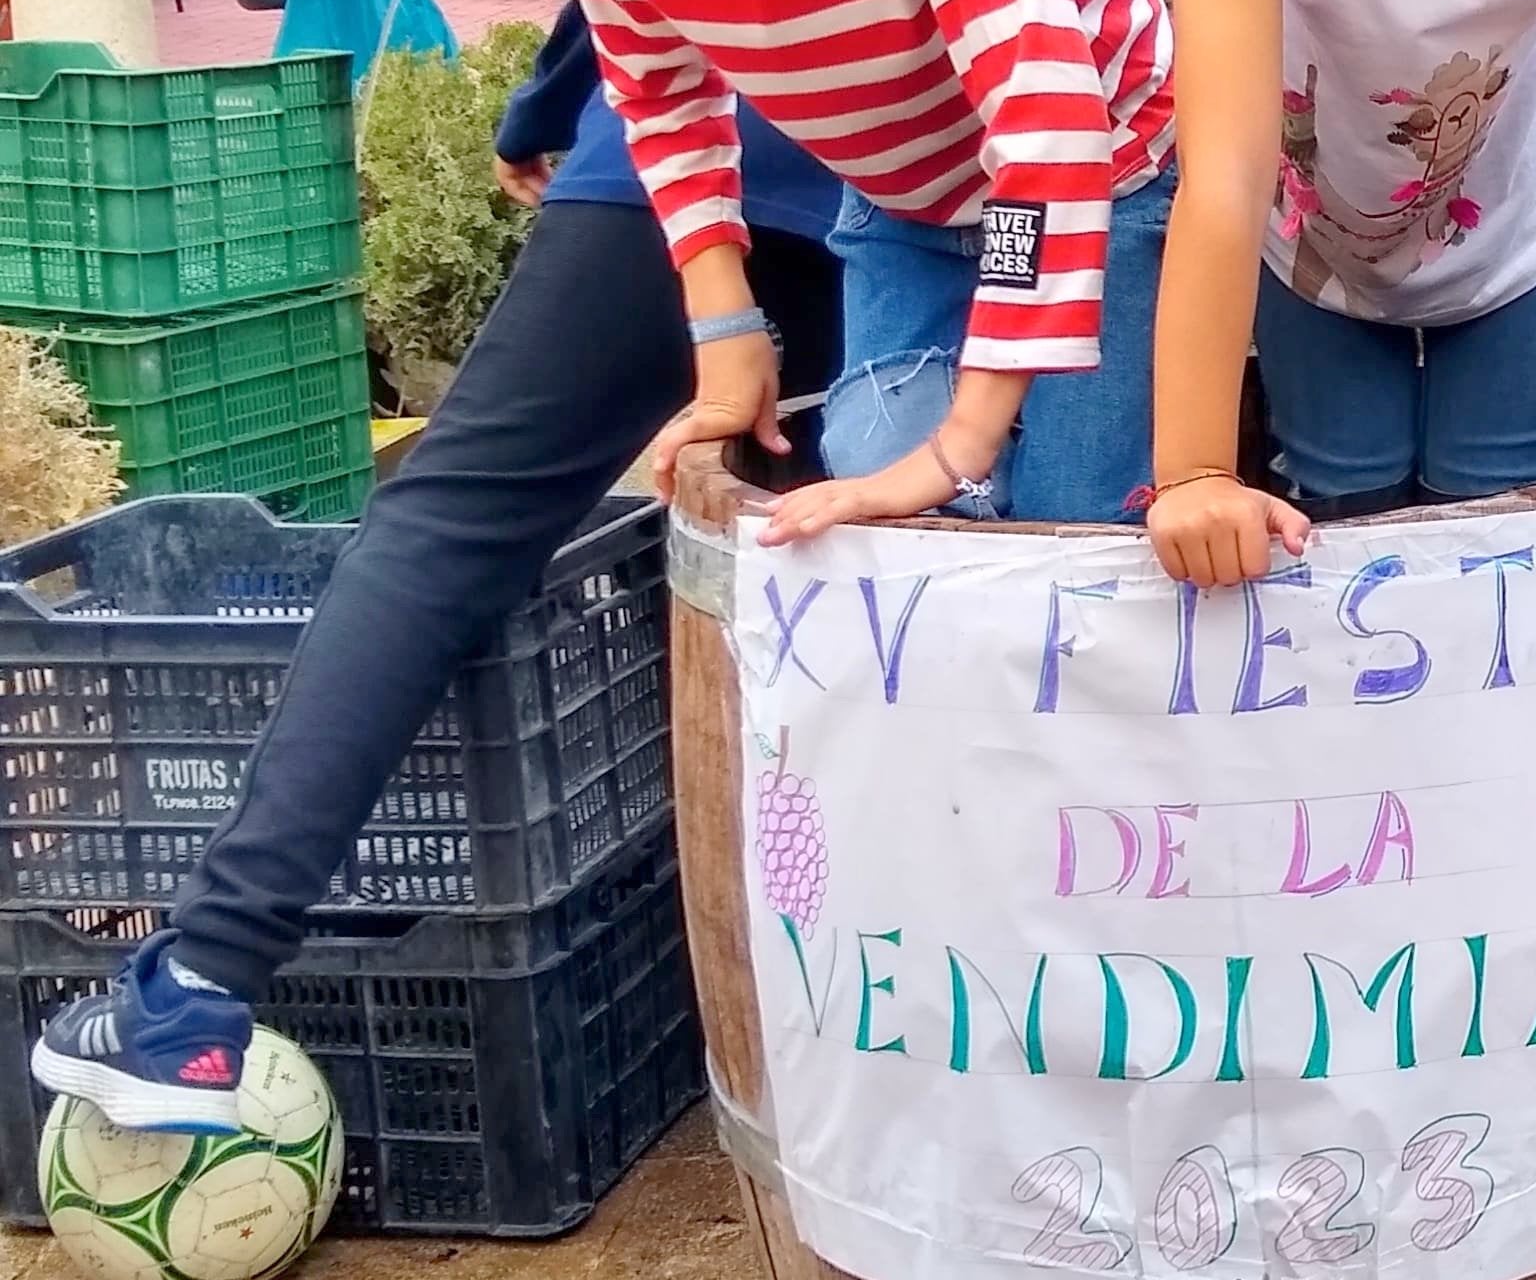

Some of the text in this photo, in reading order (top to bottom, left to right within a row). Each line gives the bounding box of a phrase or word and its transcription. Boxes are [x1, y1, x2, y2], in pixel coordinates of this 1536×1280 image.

[146, 759, 228, 790] FRUTAS
[1055, 790, 1416, 899] DE LA
[1011, 1112, 1495, 1272] 2023
